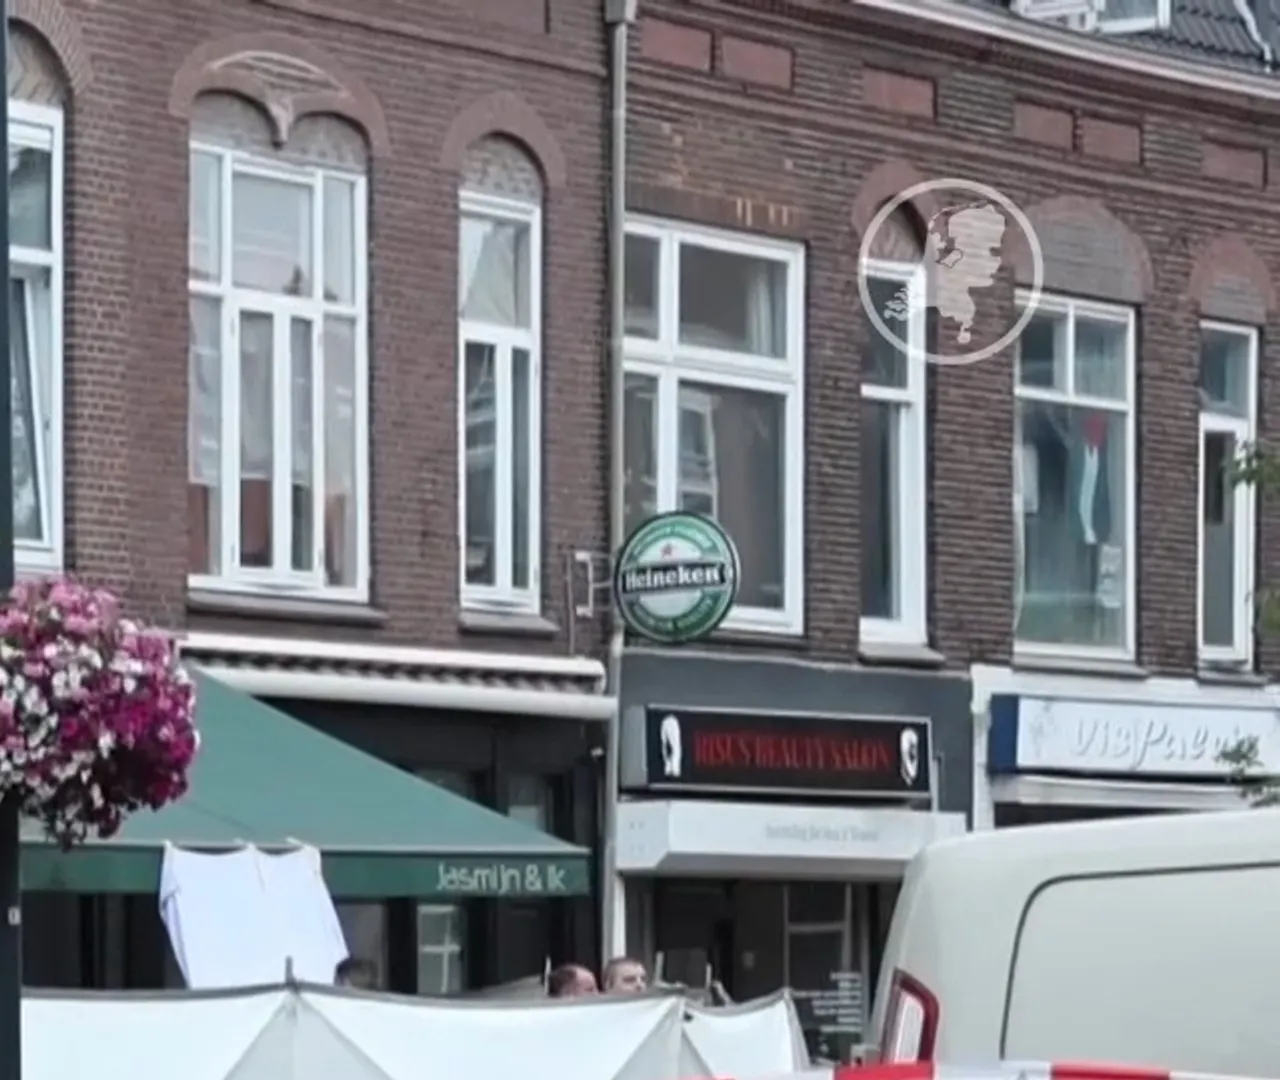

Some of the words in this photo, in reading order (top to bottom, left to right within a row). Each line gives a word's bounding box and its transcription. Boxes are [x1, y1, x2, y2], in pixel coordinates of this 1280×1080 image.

[625, 564, 720, 591] Heineken
[436, 861, 521, 895] Jasmijn
[524, 864, 542, 892] &
